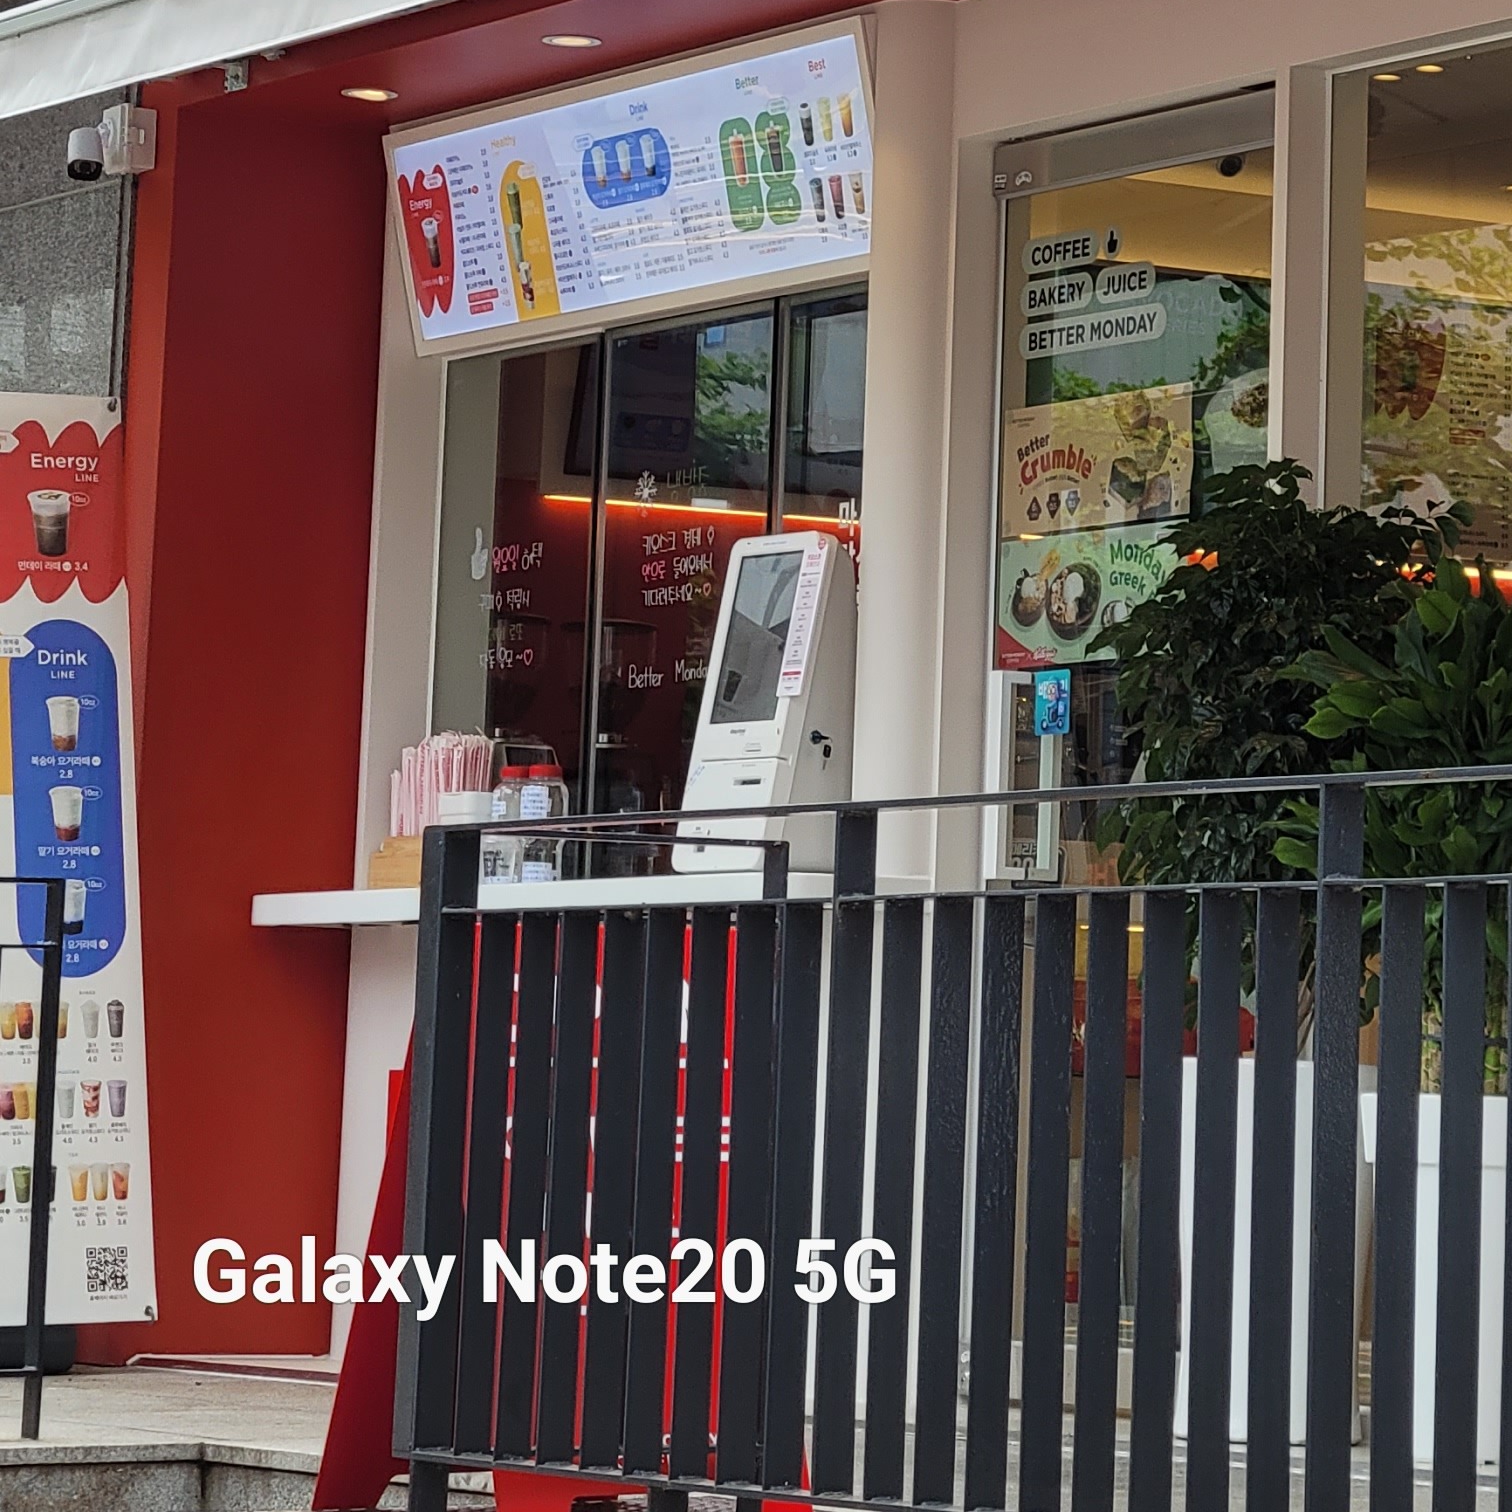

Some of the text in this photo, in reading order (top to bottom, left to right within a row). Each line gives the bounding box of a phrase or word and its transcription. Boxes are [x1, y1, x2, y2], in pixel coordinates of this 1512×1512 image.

[808, 59, 826, 72] Best
[735, 75, 759, 90] Better
[629, 102, 648, 116] Drink
[409, 197, 433, 211] Energy
[1031, 237, 1091, 267] COFFEE
[1102, 270, 1147, 296] JUICE
[1028, 281, 1085, 310] BAKERY
[1028, 312, 1157, 352] BETTER MONDAY
[1017, 434, 1050, 463] Better
[31, 452, 99, 471] Energy
[1020, 443, 1092, 486] Crumble
[75, 474, 99, 483] LINE
[642, 530, 676, 556] 키오스크
[74, 561, 88, 571] 3.4
[492, 543, 519, 574] 월요일
[641, 560, 666, 583] 안으로
[1109, 570, 1146, 596] Greek
[38, 649, 88, 666] Drink
[51, 670, 76, 679] LINE
[628, 659, 708, 688] Better Monda
[59, 769, 74, 779] 2.8
[62, 859, 77, 870] 2.8
[65, 953, 80, 963] 2.8
